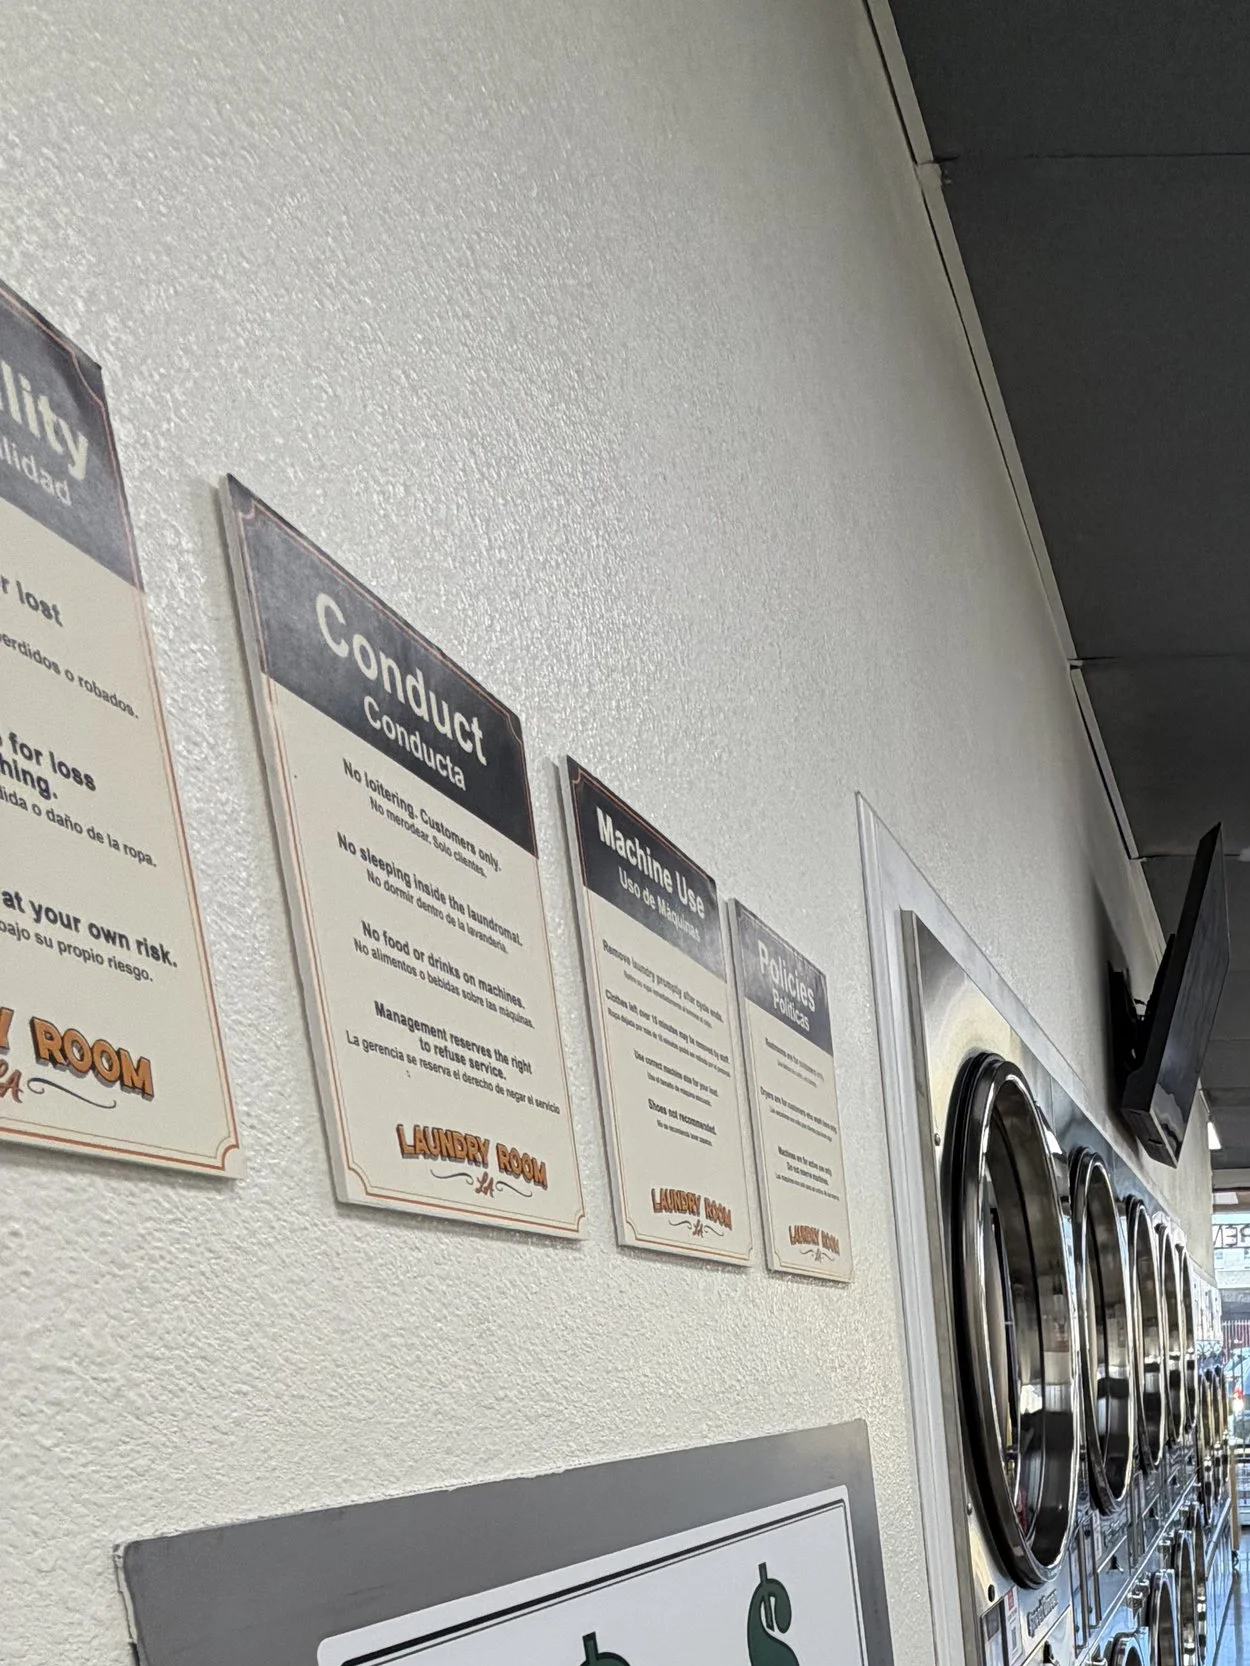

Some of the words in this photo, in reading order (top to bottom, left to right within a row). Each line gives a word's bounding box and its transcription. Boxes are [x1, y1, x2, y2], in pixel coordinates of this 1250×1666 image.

[0, 361, 88, 481] lity
[0, 436, 71, 506] lidad
[16, 580, 63, 627] lost
[0, 633, 61, 675] erdidos
[65, 669, 74, 682] o
[78, 676, 139, 719] robados.
[316, 593, 487, 766] Conduct
[9, 732, 43, 766] for
[49, 751, 96, 792] loss
[364, 696, 465, 790] Conducta
[32, 803, 42, 817] o
[46, 808, 83, 835] daño
[86, 826, 104, 845] de
[107, 834, 120, 851] la
[123, 843, 157, 868] ropa.
[343, 758, 361, 783] No
[364, 772, 417, 819] loitering.
[420, 809, 476, 855] Customers
[479, 849, 501, 872] only.
[370, 796, 384, 815] No
[386, 809, 431, 844] merodear.
[433, 835, 452, 857] Solo
[337, 832, 356, 855] No
[360, 848, 411, 888] sleeping
[413, 874, 446, 905] inside
[449, 895, 465, 915] the
[597, 807, 672, 893] Machine
[676, 872, 705, 919] Use
[619, 867, 640, 898] Uso
[643, 888, 655, 909] de
[1, 890, 26, 914] at
[29, 900, 81, 934] your
[88, 921, 130, 951] own
[136, 937, 178, 968] risk.
[367, 869, 381, 887] No
[384, 880, 414, 904] dormir
[416, 897, 444, 920] dentro
[446, 913, 456, 927] de
[458, 918, 465, 932] la
[34, 932, 54, 949] su
[57, 939, 104, 966] propio
[108, 956, 153, 982] riesgo.
[354, 938, 369, 955] No
[371, 948, 417, 977] alimentos
[419, 970, 425, 980] o
[427, 971, 460, 996] bebidas
[462, 990, 484, 1006] sobre
[486, 998, 497, 1012] las
[362, 920, 380, 942] No
[383, 930, 410, 955] food
[413, 949, 425, 962] or
[428, 953, 460, 979] drinks
[463, 973, 476, 986] on
[478, 979, 525, 1009] machines.
[758, 940, 815, 1011] Policies
[29, 1016, 154, 1102] ROOM
[346, 1030, 360, 1046] La
[362, 1039, 404, 1061] gerencia
[406, 1054, 417, 1065] se
[419, 1058, 451, 1077] reserva
[453, 1070, 460, 1080] el
[462, 1072, 493, 1091] derecho
[495, 1083, 504, 1095] de
[506, 1089, 526, 1103] negar
[374, 1001, 447, 1041] Management
[450, 1033, 492, 1059] reserves
[494, 1049, 509, 1065] the
[511, 1056, 532, 1074] right
[419, 1037, 431, 1052] to
[434, 1045, 466, 1065] refuse
[469, 1058, 506, 1080] service.
[648, 1098, 667, 1115] Shoes
[397, 1124, 489, 1168] LAUNDRY
[496, 1143, 548, 1190] ROOM
[651, 1188, 701, 1217] LAUNDRY
